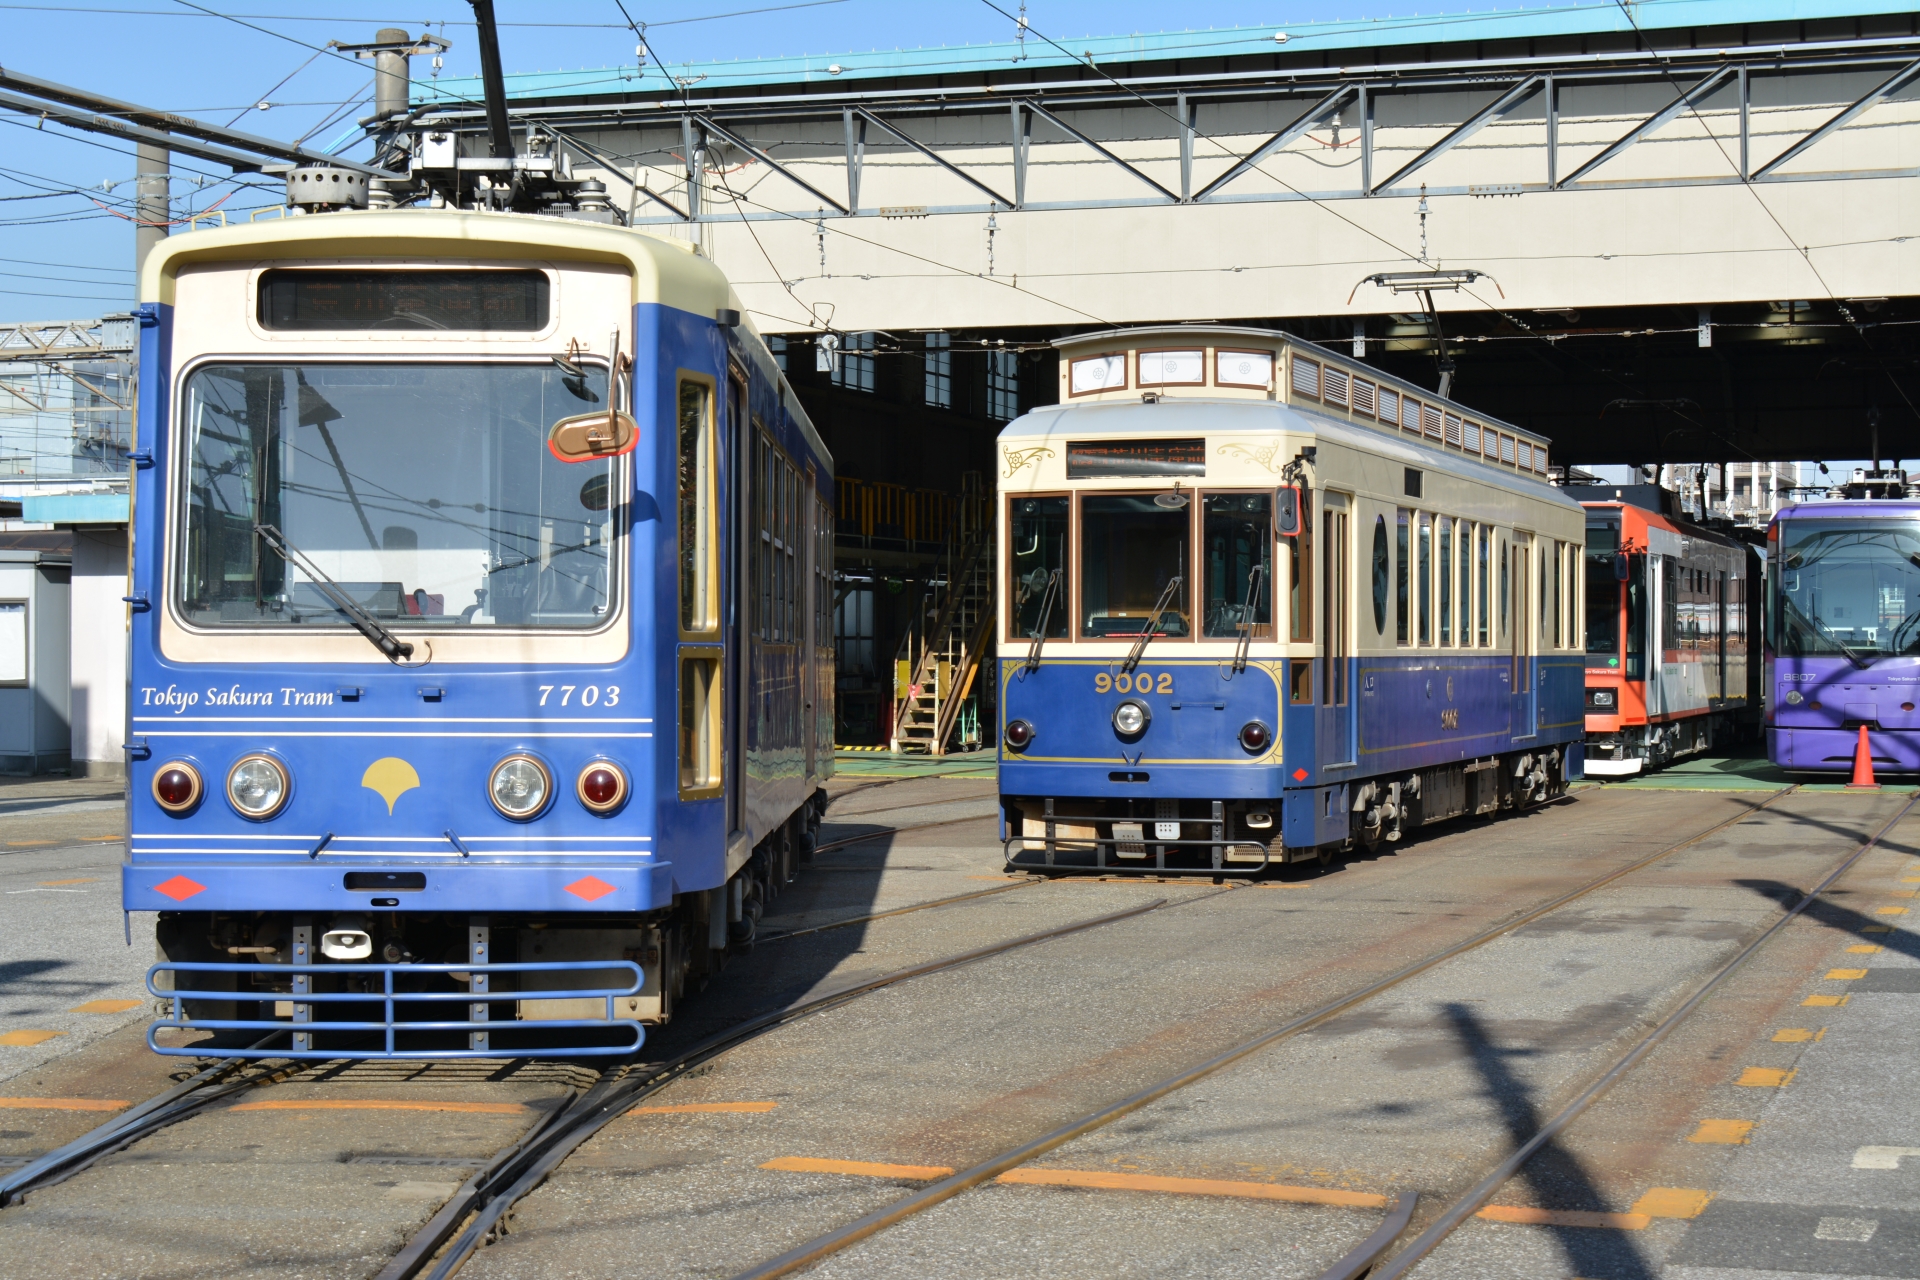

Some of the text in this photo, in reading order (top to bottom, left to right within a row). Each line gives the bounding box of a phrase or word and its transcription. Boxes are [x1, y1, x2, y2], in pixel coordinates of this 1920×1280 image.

[1094, 672, 1173, 694] 9002
[1783, 673, 1816, 681] 8807
[141, 684, 334, 714] Tokyo Sakura Tram
[538, 685, 620, 707] 7703
